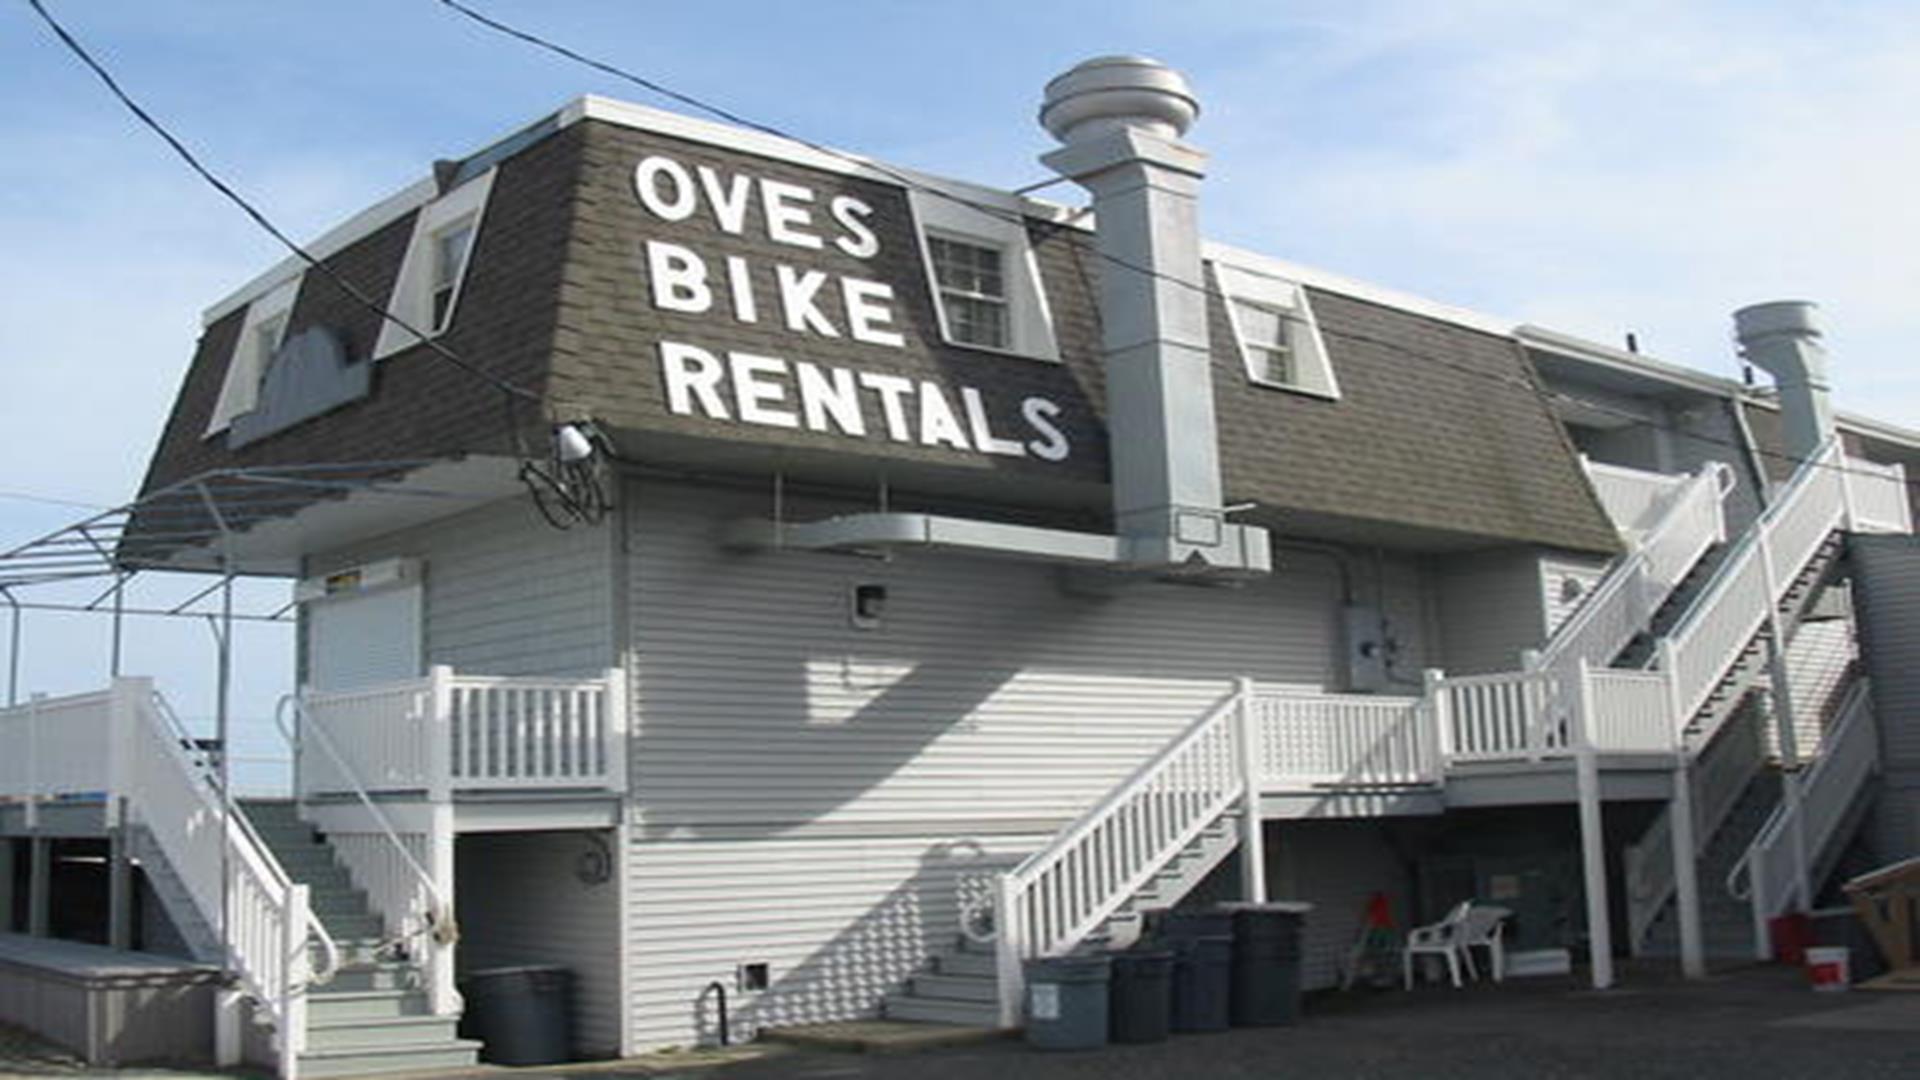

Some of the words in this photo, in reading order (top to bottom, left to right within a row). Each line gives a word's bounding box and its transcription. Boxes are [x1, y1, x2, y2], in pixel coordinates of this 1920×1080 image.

[635, 154, 880, 259] OVES
[646, 239, 906, 347] BIKE
[660, 340, 1070, 462] RENTALS
